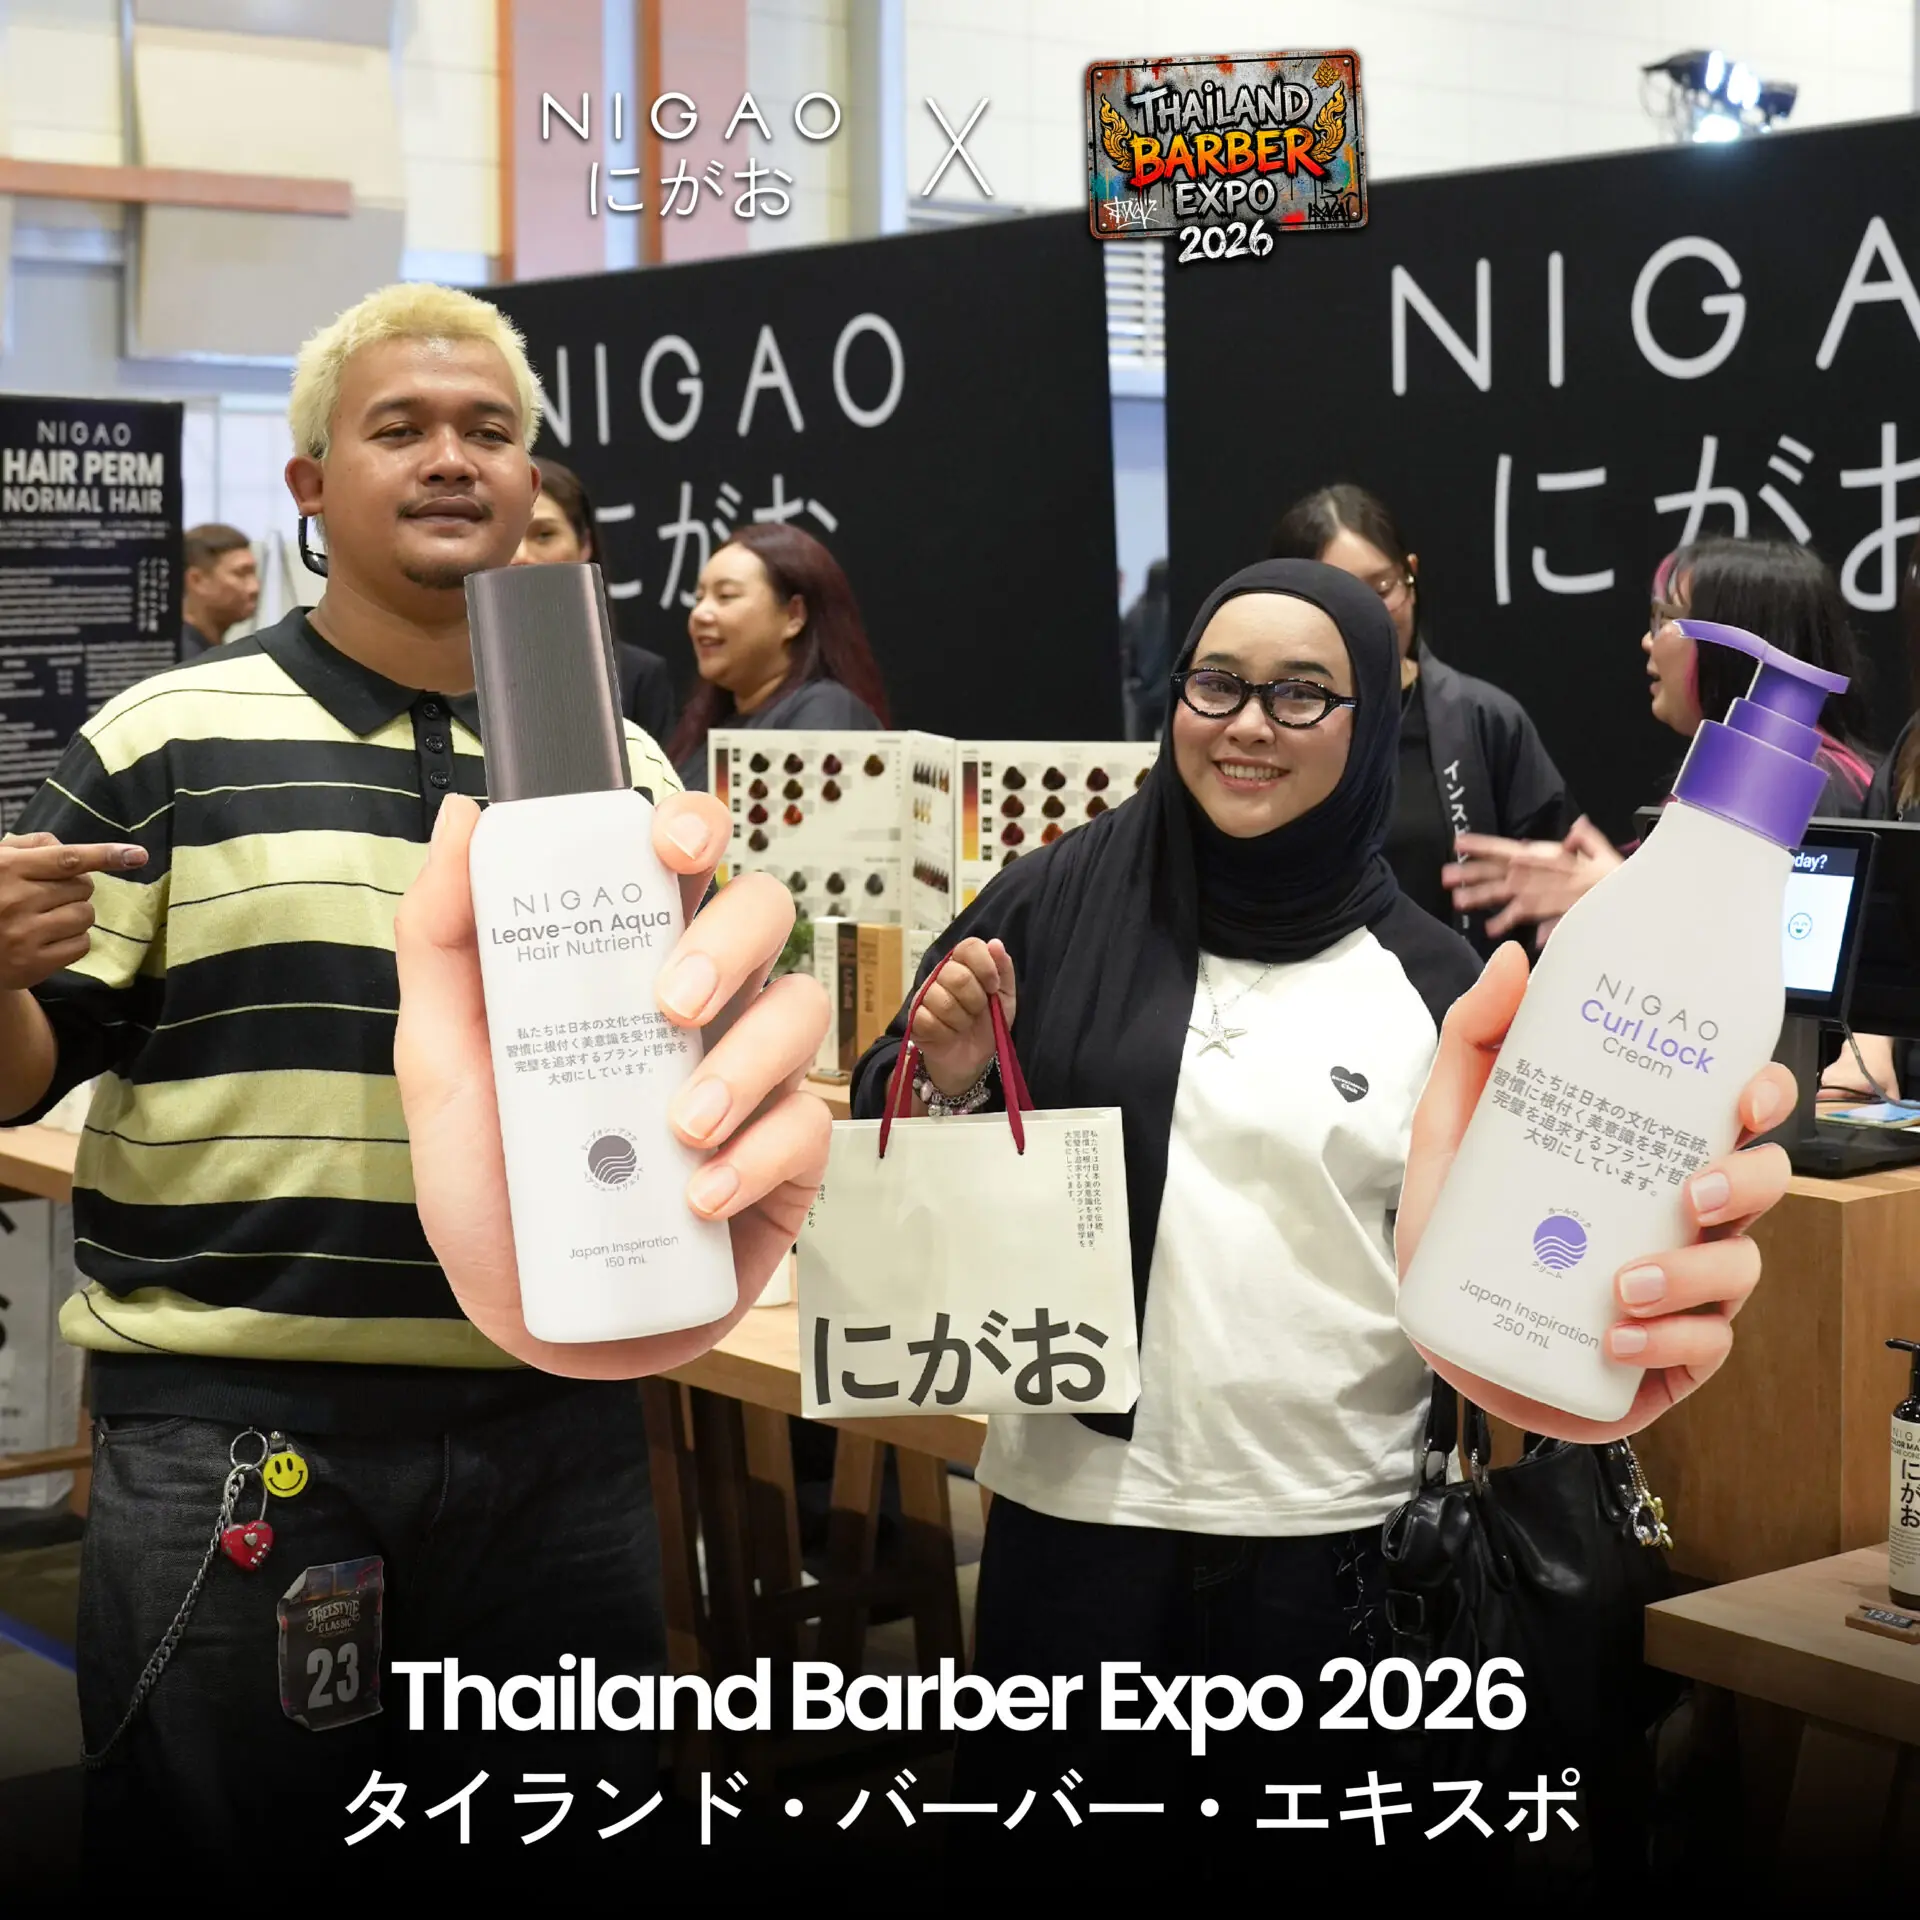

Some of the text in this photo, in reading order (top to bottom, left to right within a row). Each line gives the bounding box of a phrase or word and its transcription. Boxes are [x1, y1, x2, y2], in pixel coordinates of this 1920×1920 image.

[36, 419, 132, 448] NIGAO
[2, 447, 165, 488] HAIR PERM
[2, 486, 164, 514] NORMAL HAIR
[513, 882, 644, 918] NIGAO
[491, 908, 673, 946] Leave-on Aqua
[516, 932, 653, 964] Hair Nutrient
[1595, 972, 1720, 1043] NIGAO
[1579, 998, 1715, 1075] Curl Lock
[1602, 1036, 1674, 1080] Cream
[1492, 1066, 1711, 1174] 習慣に根付く美意識を受け継
[1492, 1089, 1694, 1187] 完璧を追求するブランド哲
[1523, 1126, 1659, 1198] 大切にしています。
[569, 1234, 680, 1261] Japan Inspiration
[604, 1255, 626, 1269] 150
[1459, 1279, 1600, 1352] Japan Inspiration
[1492, 1313, 1551, 1351] 250 mL
[814, 1307, 1109, 1407] にがお
[306, 1642, 360, 1710] 23
